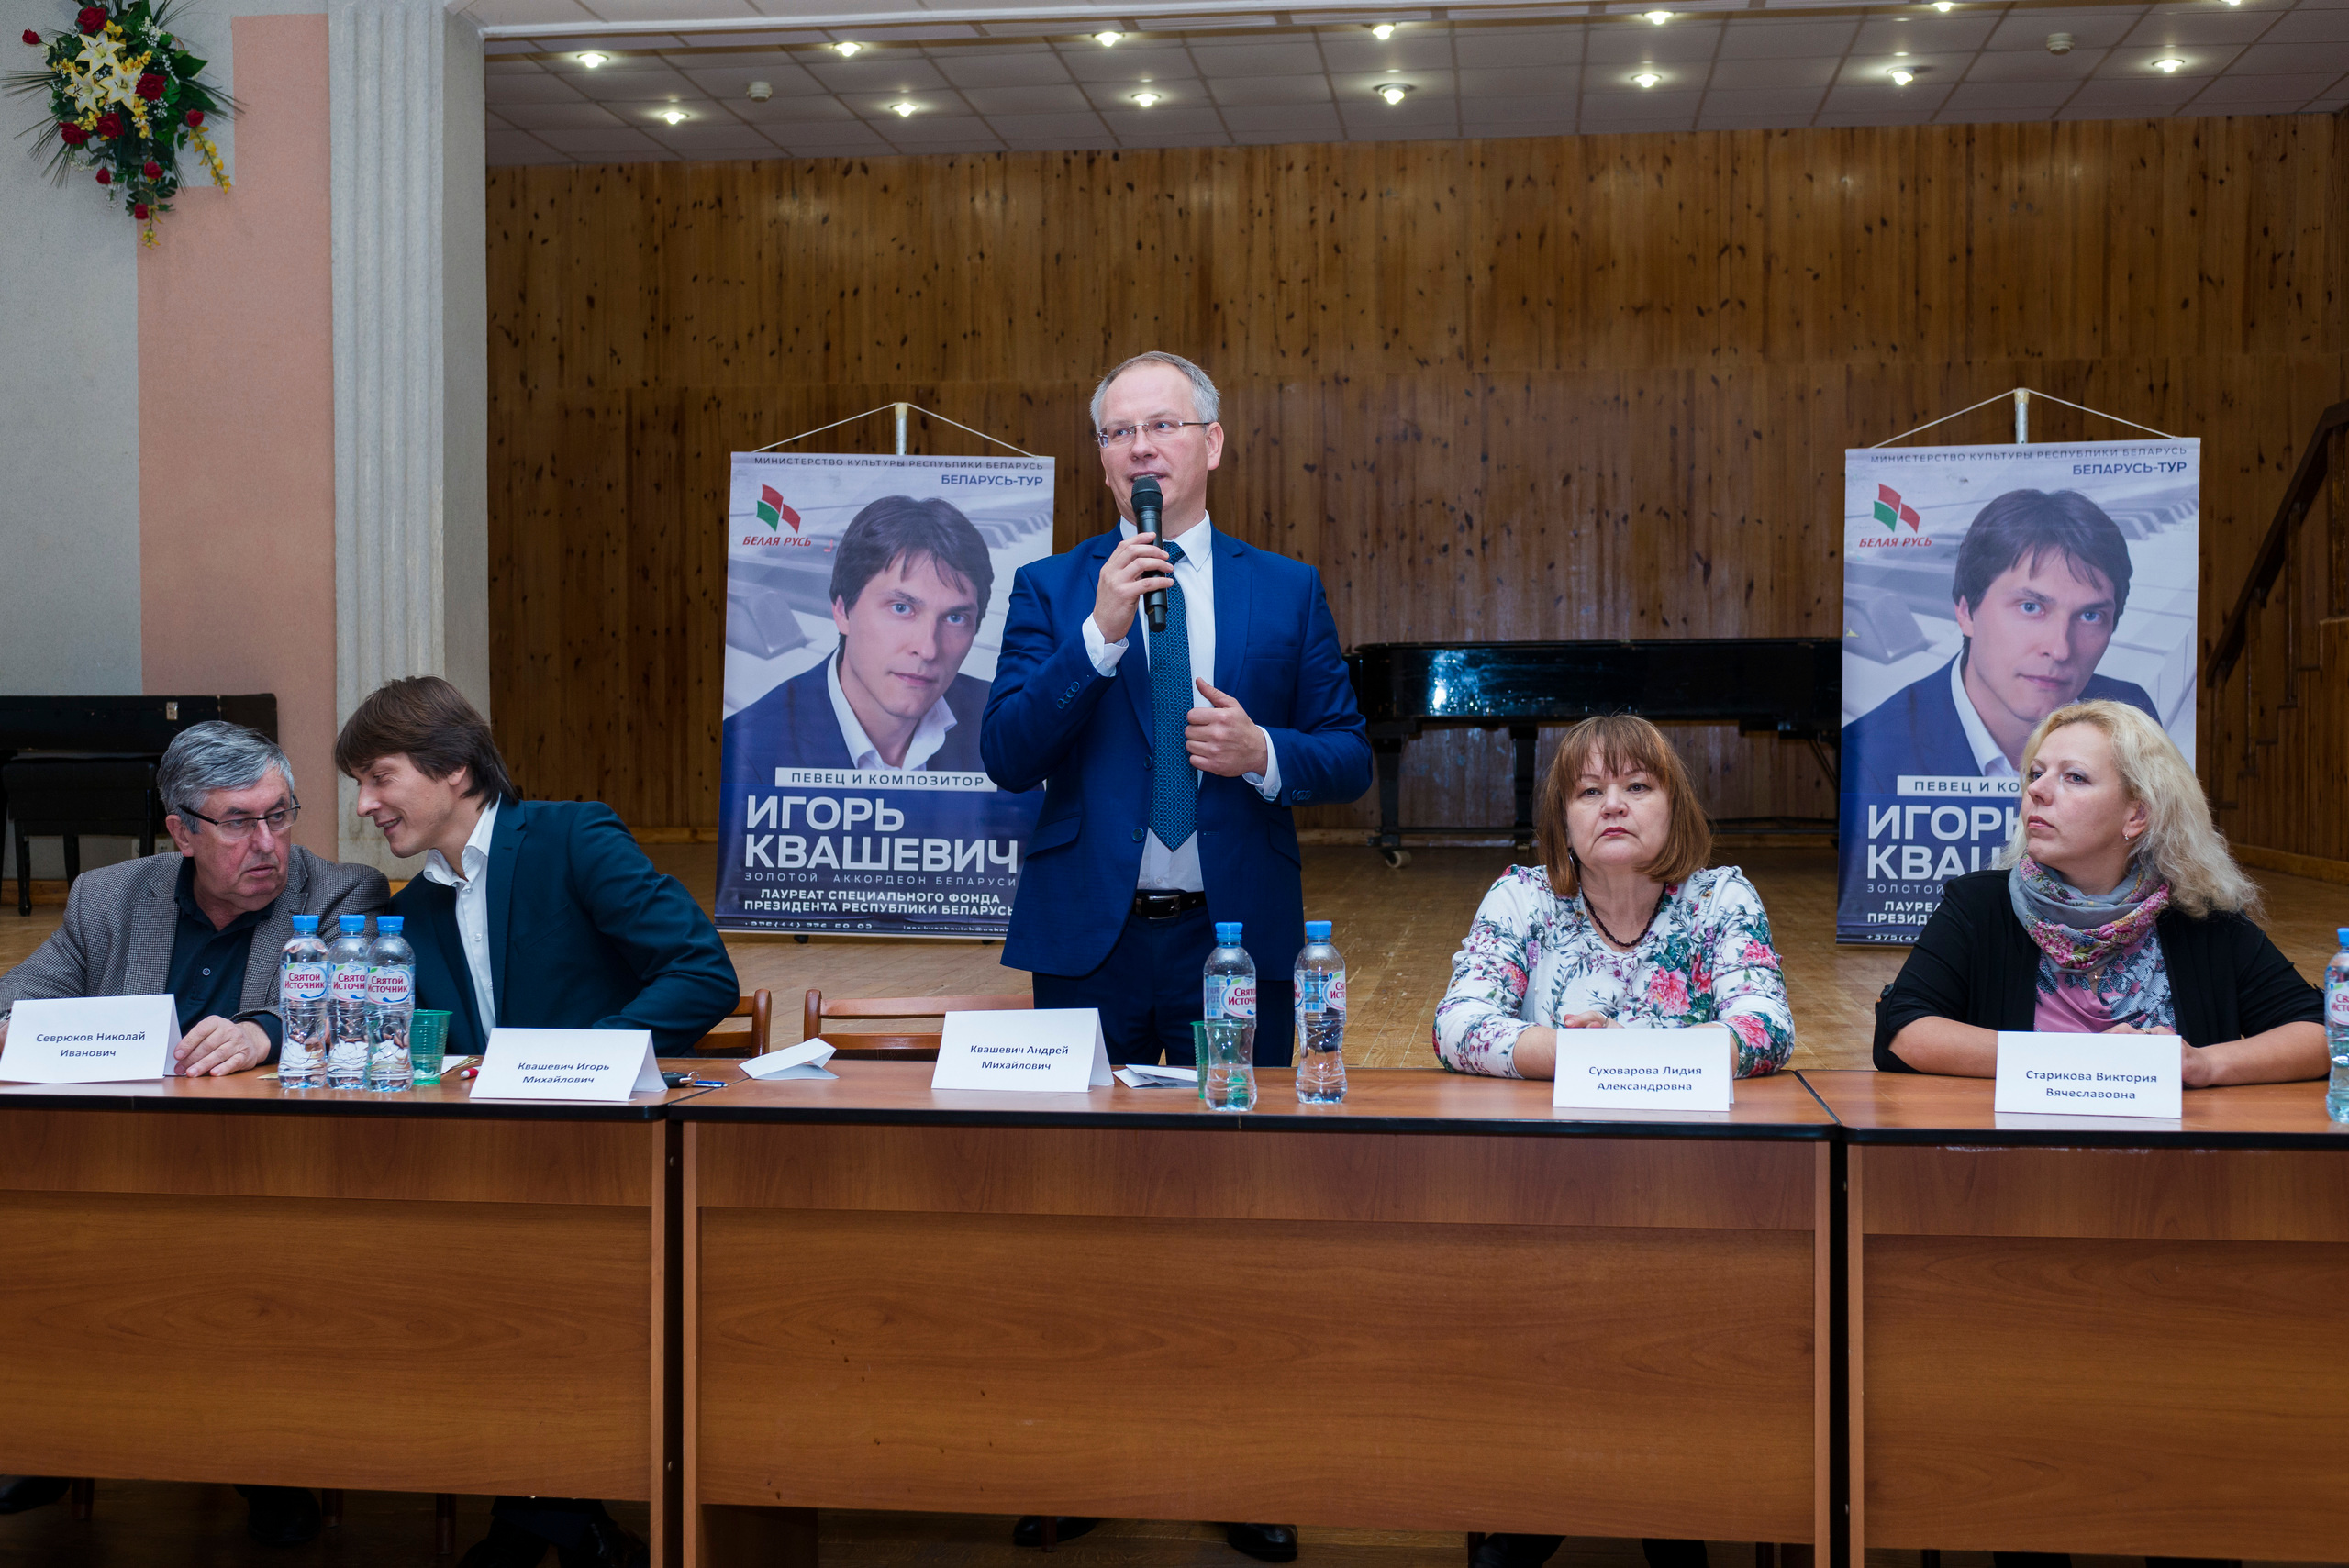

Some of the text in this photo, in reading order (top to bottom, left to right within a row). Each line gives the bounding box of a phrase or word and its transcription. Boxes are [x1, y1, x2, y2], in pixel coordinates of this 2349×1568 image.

[1870, 447, 2187, 463] МИНИСТЕРСТВО КУЛЬТУРЫ РЕСПУБЛИКИ БЕЛАРУСЬ
[754, 457, 1043, 470] МИНИСТЕРСТВО КУЛЬТУРЫ РЕСПУБЛИКИ БЕЛАРУСЬ
[2072, 462, 2188, 475] БЕЛАРУСЬ-ТУР
[941, 474, 1043, 486] БЕЛАРУСЬ-ТУР
[742, 535, 812, 548] БЕЛАЯ РУСЬ
[1858, 537, 1932, 549] БЕЛАЯ РУСЬ
[791, 773, 985, 786] ПЕВЕЦ И КОМПОЗИТОР
[1914, 781, 1972, 794] ПЕВЕЦ
[1979, 782, 1989, 792] И
[747, 795, 905, 832] ИГОРЬ
[745, 834, 1018, 873] КВАШЕВИЧ
[744, 872, 1016, 887] ЗОЛОТОЙ АККОРДЕОН БЕЛАРУСИ
[1867, 884, 1944, 894] ЗОЛОТОЙ
[761, 888, 1000, 905] ЛАУРЕАТ СПЕЦИАЛЬНОГО ФОНДА
[744, 900, 838, 913] ПРЕЗИДЕНТА
[841, 902, 938, 915] РЕСПУБЛИКИ
[1867, 913, 1932, 926] ПРЕЗИД
[288, 973, 321, 982] Святой
[371, 975, 404, 984] Святой
[284, 981, 325, 989] Источник
[367, 984, 408, 993] Источник
[36, 1031, 145, 1044] Севрюков Николай
[60, 1049, 117, 1057] Иванович
[970, 1045, 1069, 1056] Квашевич Андрей
[518, 1062, 610, 1072] Квашевич Игорь
[981, 1061, 1051, 1070] Михайлович
[1588, 1066, 1702, 1076] Суховарова Лидия
[522, 1075, 595, 1084] Михайлович
[2025, 1070, 2157, 1084] Старикова Виктория
[1597, 1082, 1692, 1093] Александровна
[2045, 1087, 2136, 1099] Вячеславовна
